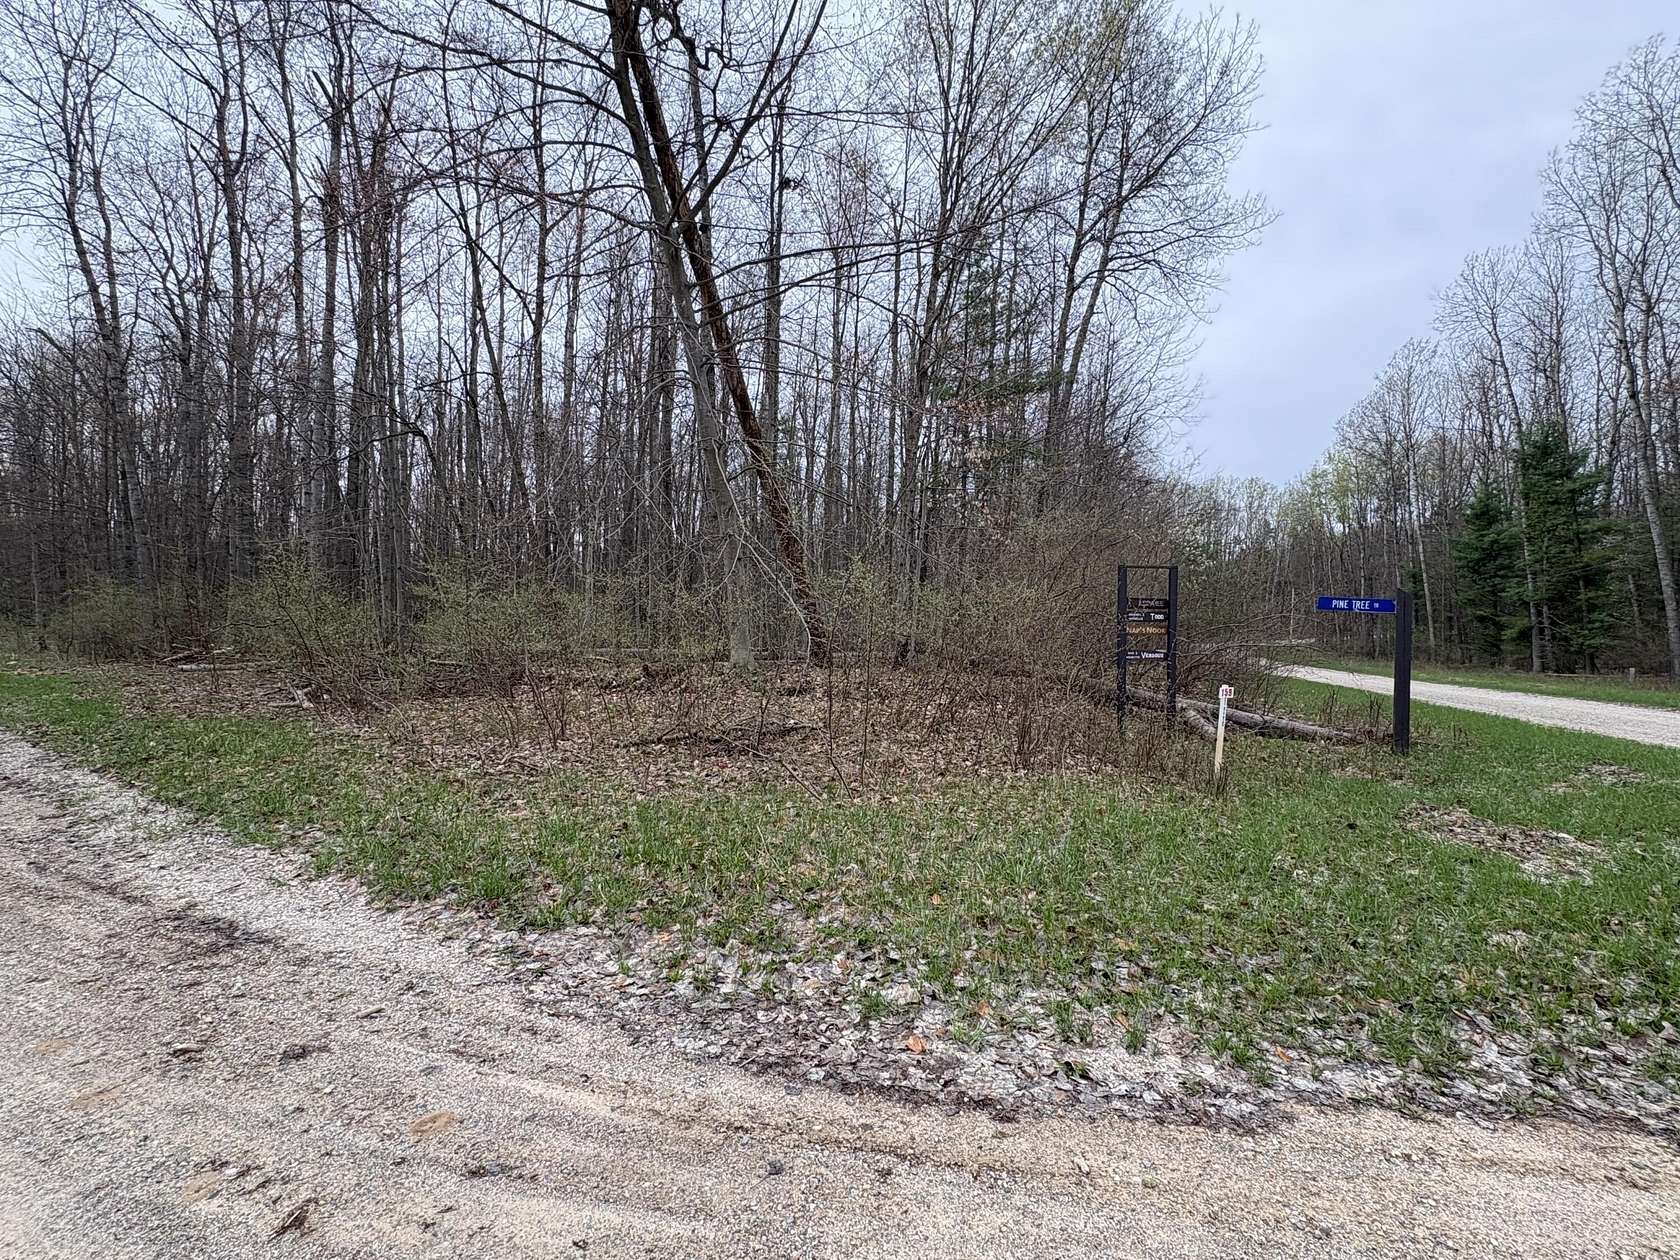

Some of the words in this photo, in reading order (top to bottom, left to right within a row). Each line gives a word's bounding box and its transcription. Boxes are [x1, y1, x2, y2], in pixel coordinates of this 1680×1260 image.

[1332, 600, 1349, 608] PINE
[1352, 600, 1371, 609] TREE
[1146, 626, 1166, 634] NOOK
